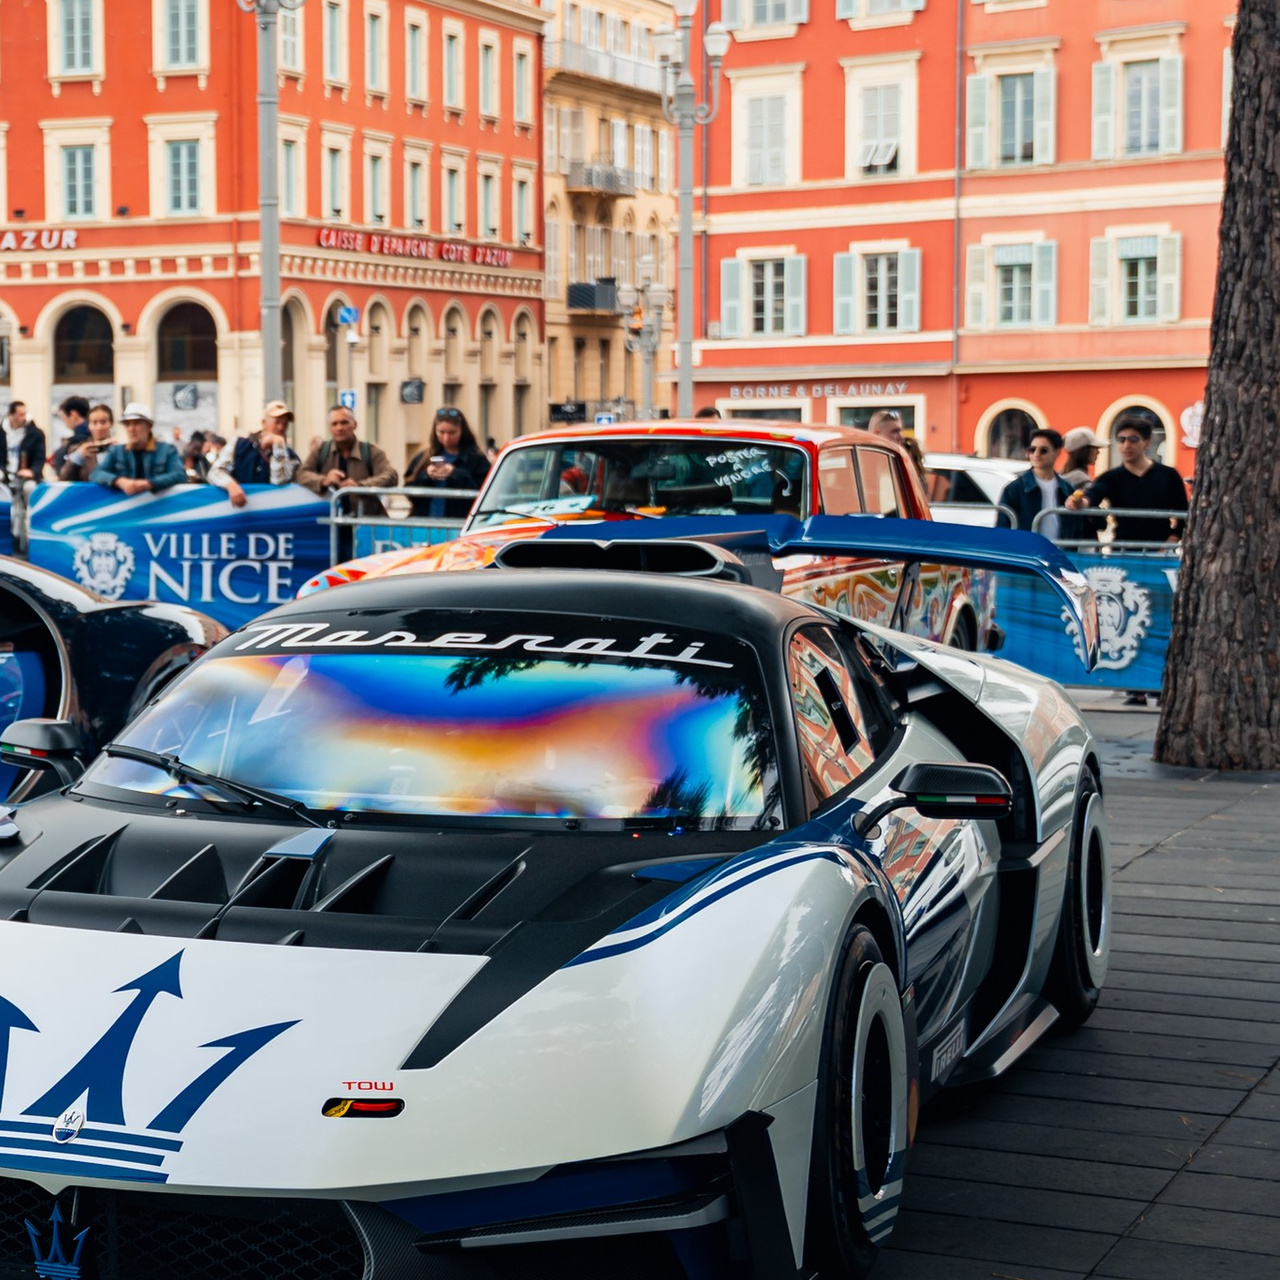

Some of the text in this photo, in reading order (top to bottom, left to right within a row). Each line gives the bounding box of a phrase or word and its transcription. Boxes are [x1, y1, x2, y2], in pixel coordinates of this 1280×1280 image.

[319, 227, 363, 251] CAISSE
[441, 242, 470, 263] COTE
[475, 246, 514, 268] D'AZUR
[730, 382, 908, 400] BORNE & DELAUNAY
[143, 533, 295, 560] VILLE DE
[147, 560, 296, 604] NICE
[235, 623, 734, 668] Maserati
[930, 1018, 966, 1082] PIRELLI
[342, 1081, 394, 1091] TOW
